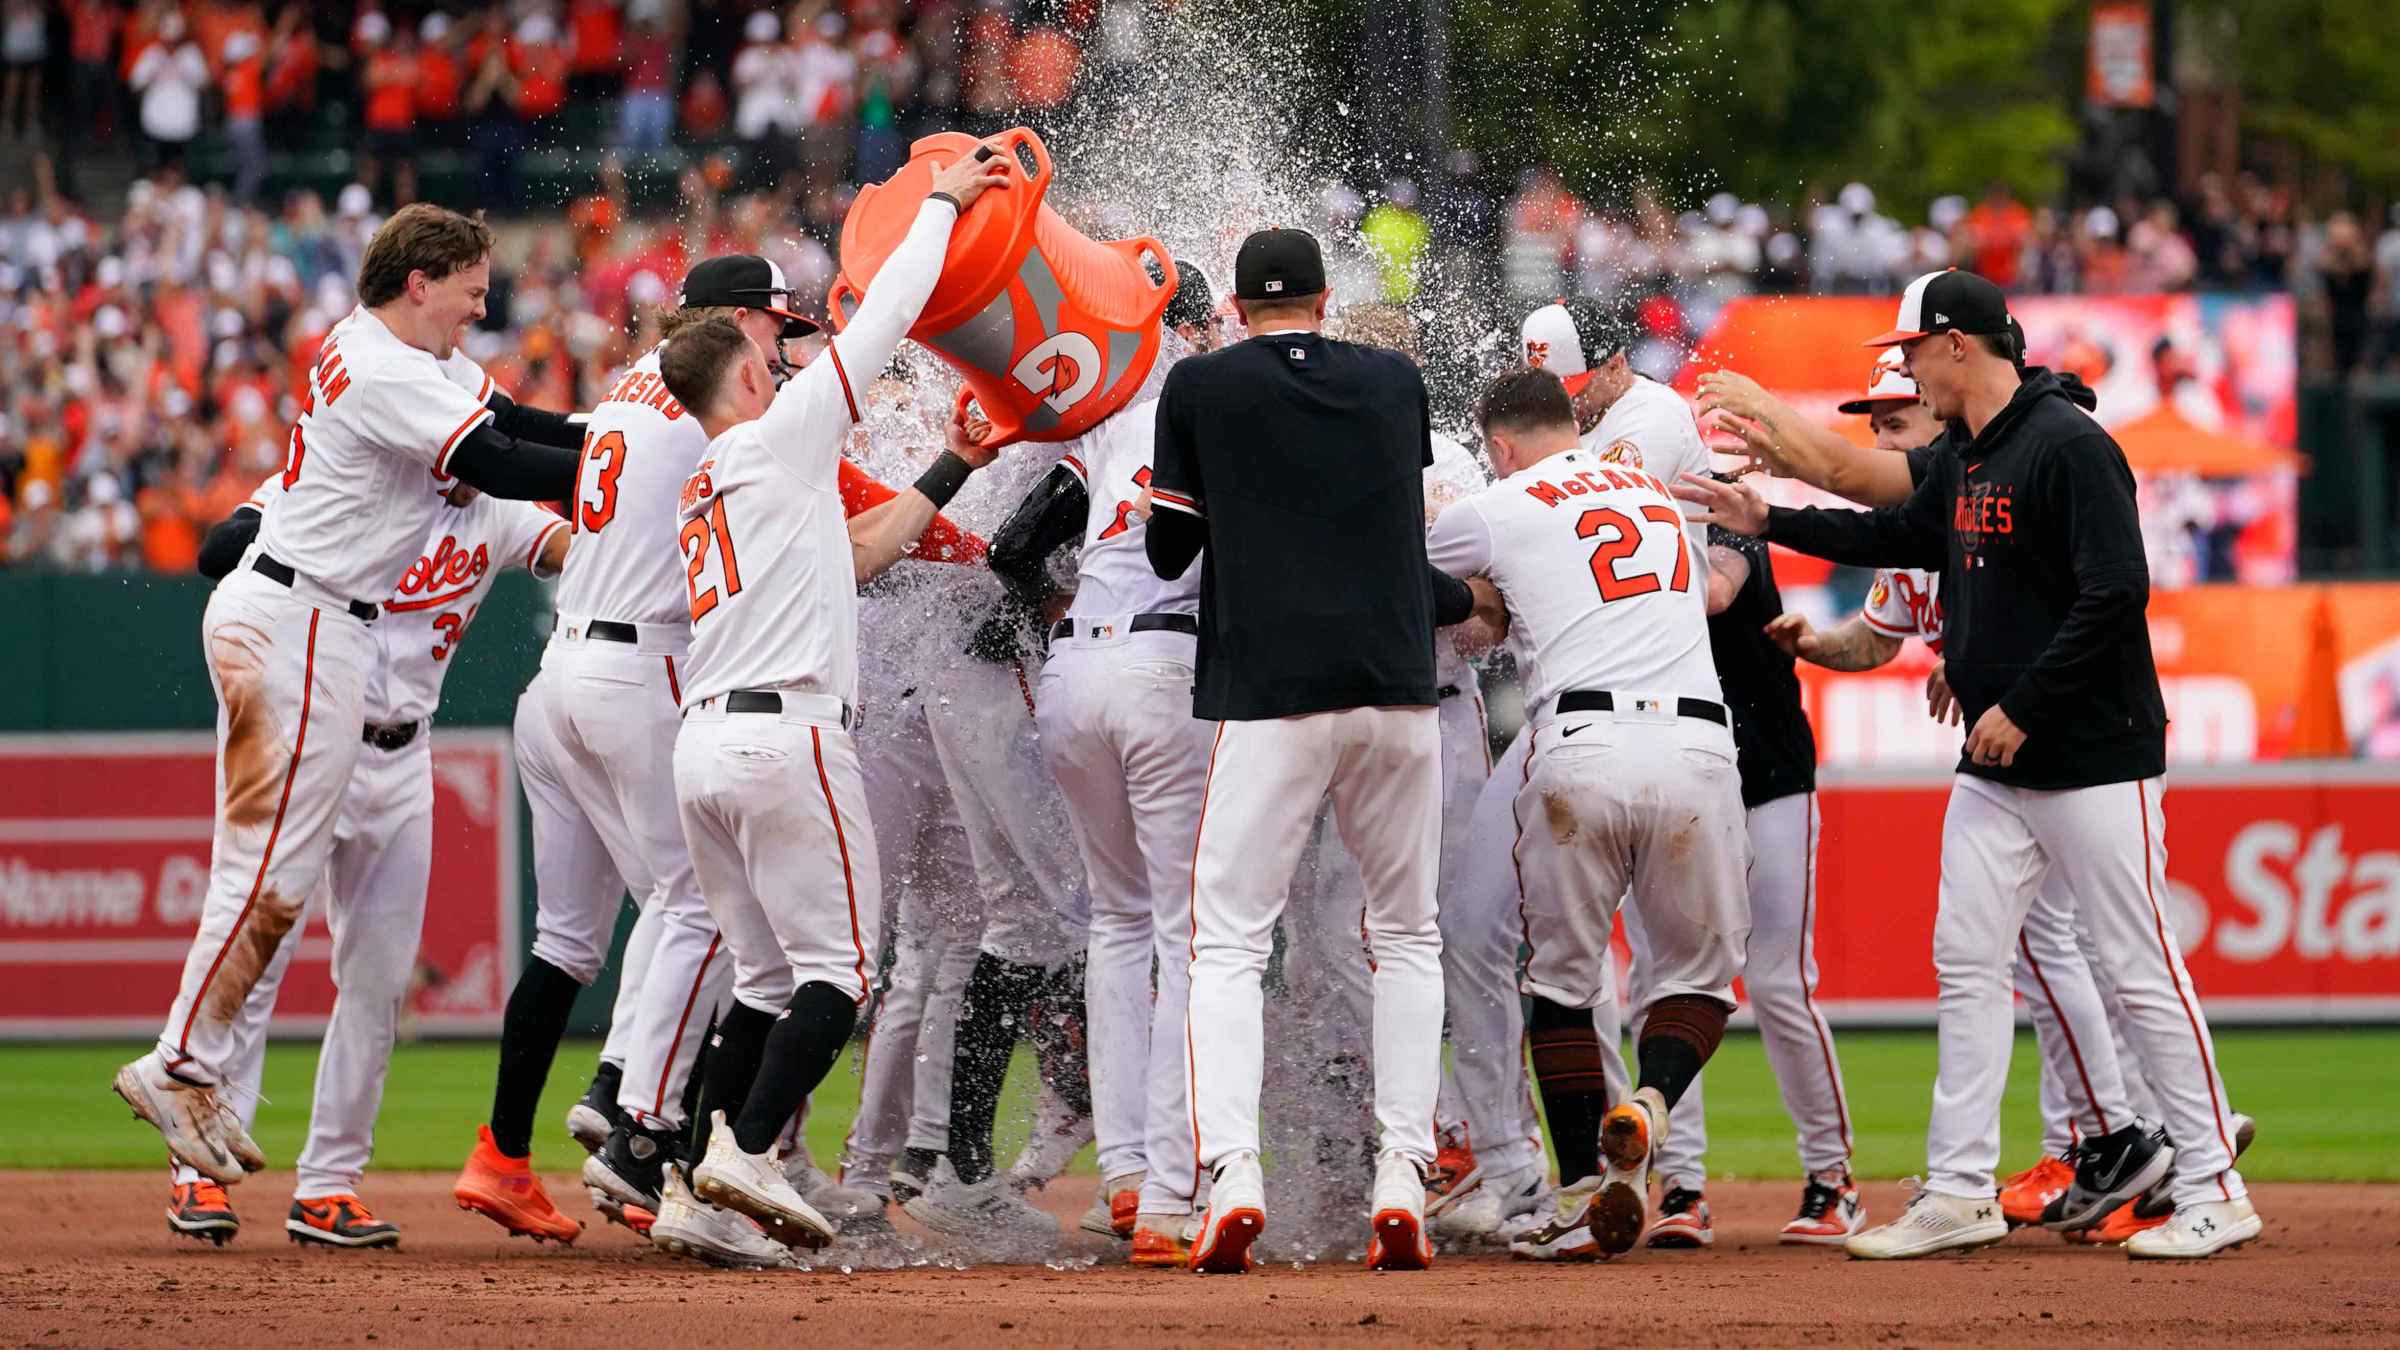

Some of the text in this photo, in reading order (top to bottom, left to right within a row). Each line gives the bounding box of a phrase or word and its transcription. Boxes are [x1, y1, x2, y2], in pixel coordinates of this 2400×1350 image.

[571, 430, 627, 535] 13
[679, 491, 743, 627] 21
[1575, 504, 1690, 603] 27
[432, 604, 477, 662] 3
